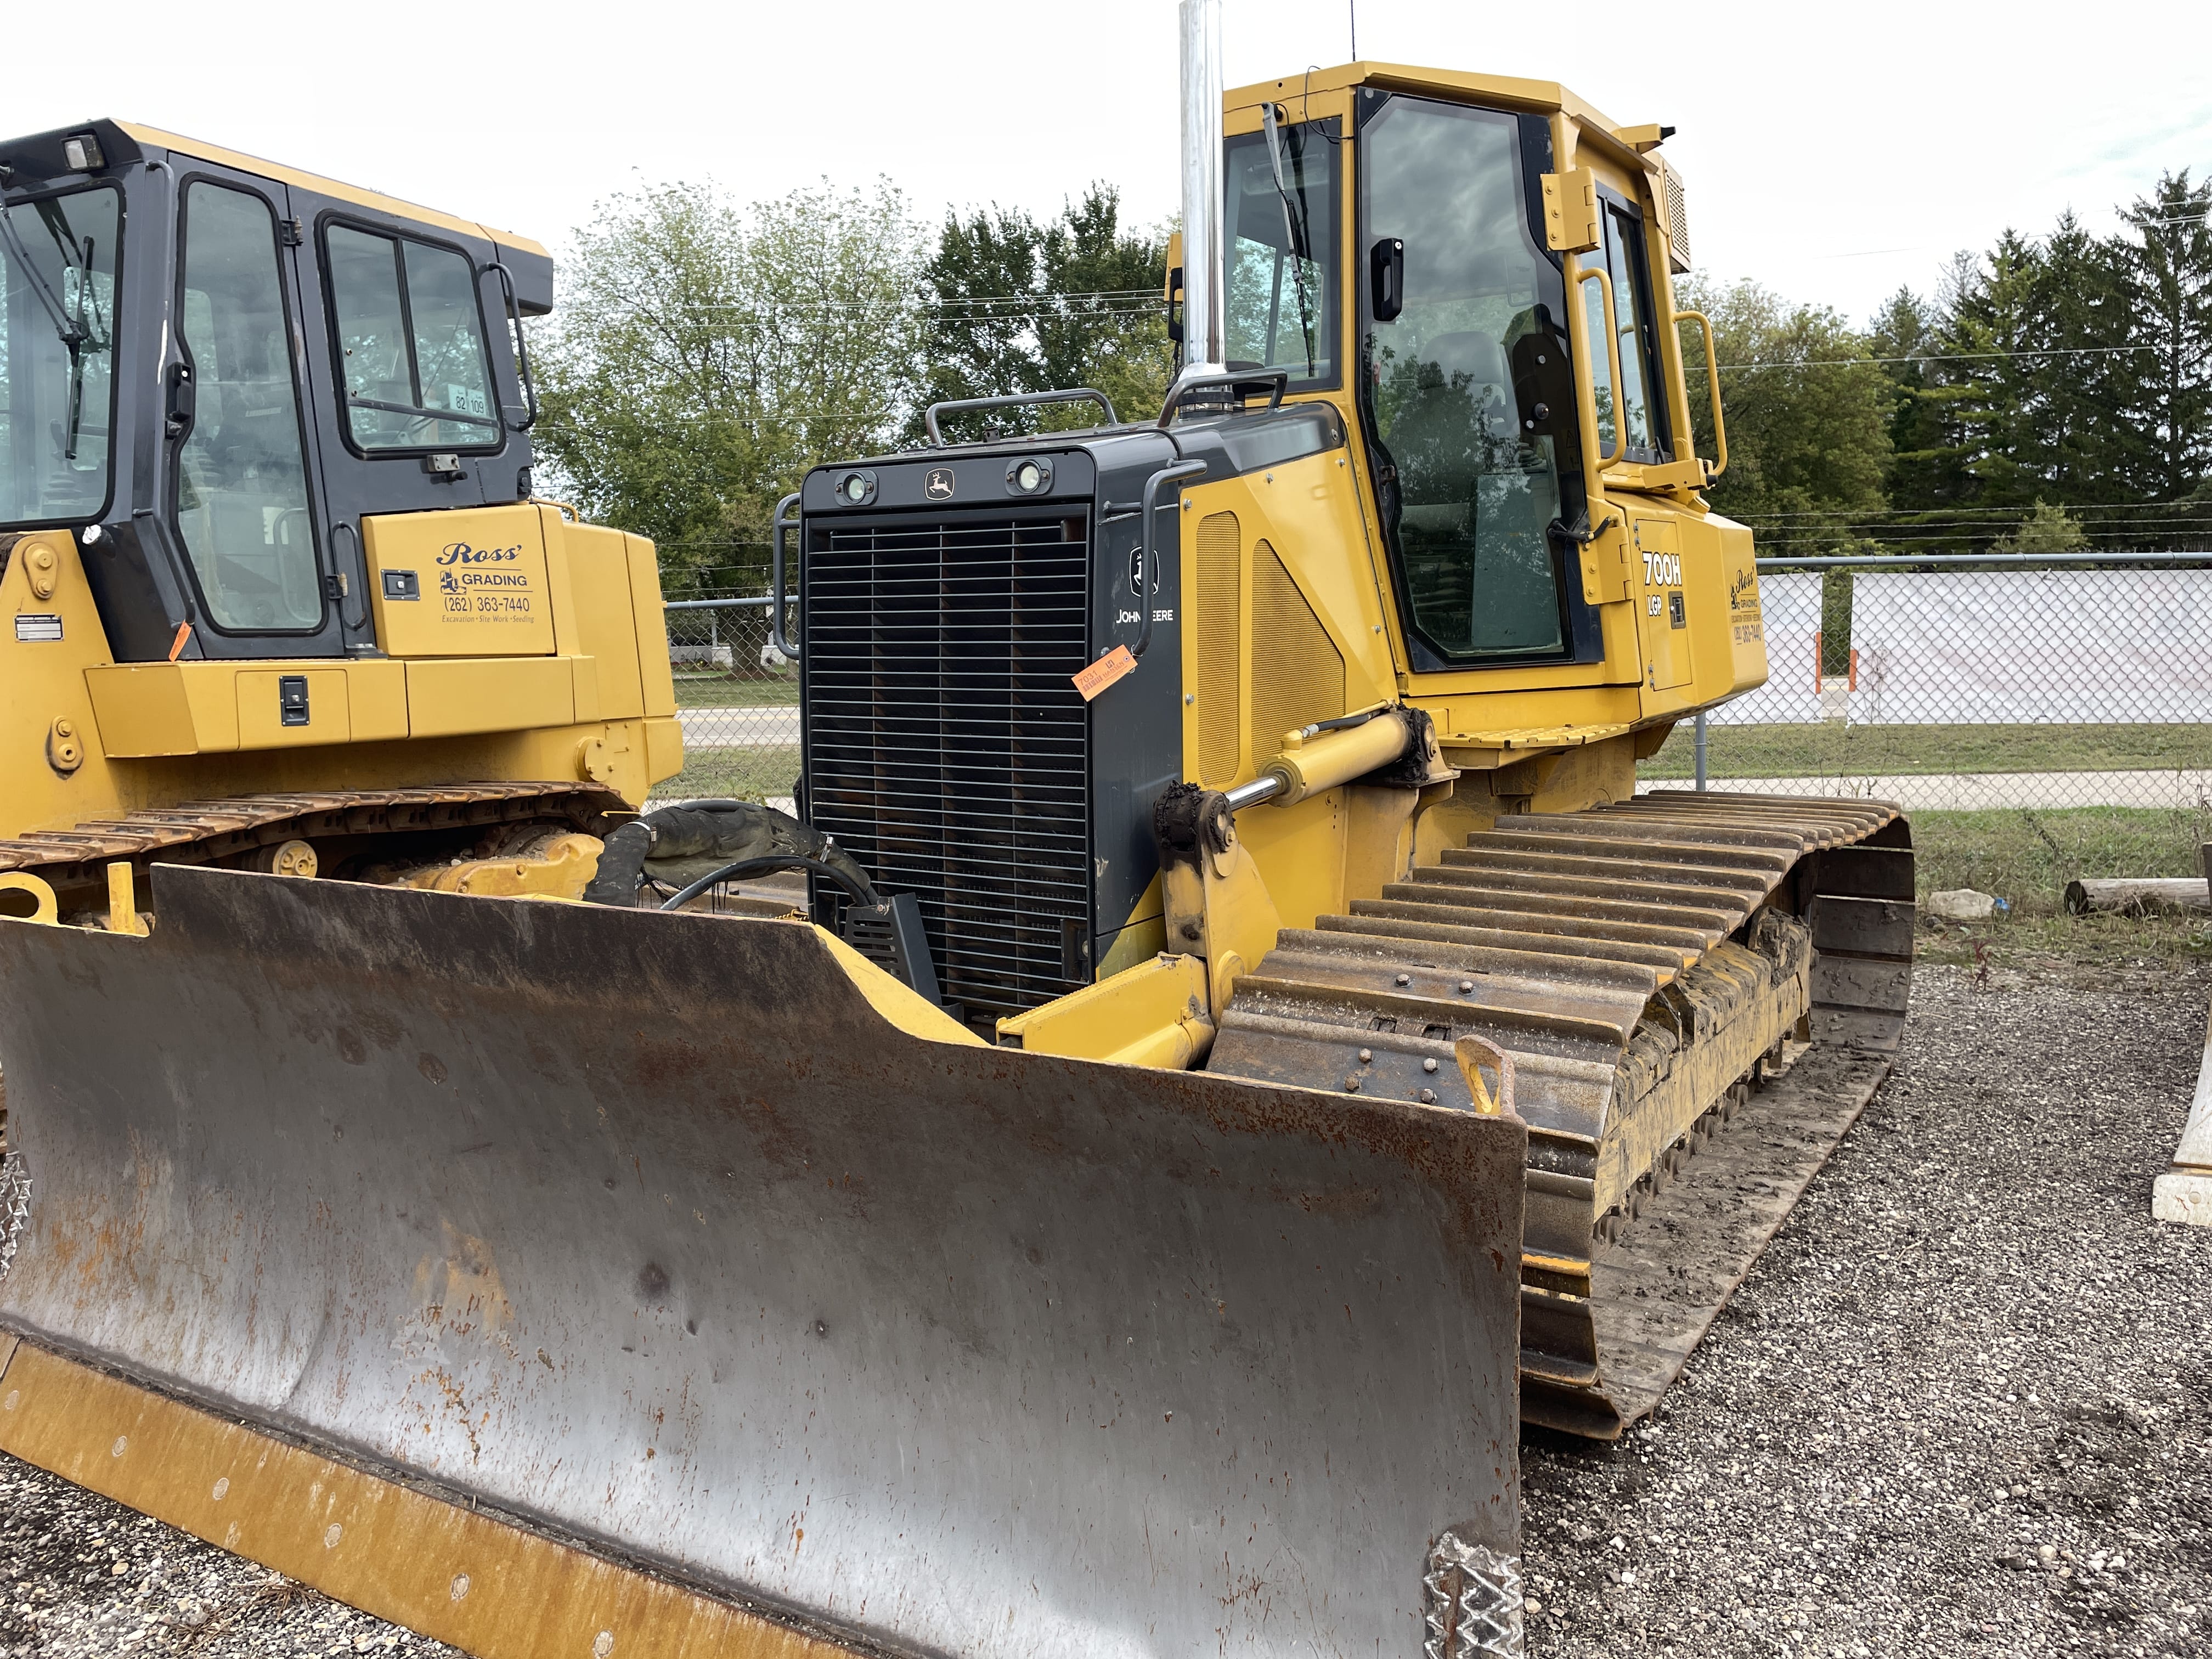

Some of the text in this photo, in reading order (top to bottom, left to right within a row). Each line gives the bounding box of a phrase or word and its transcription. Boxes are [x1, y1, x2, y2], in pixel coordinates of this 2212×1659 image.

[456, 396, 465, 409] 82
[471, 400, 483, 414] 109
[436, 541, 522, 565] Ross'
[1642, 551, 1682, 586] 700H
[462, 574, 527, 586] GRADING
[444, 597, 529, 612] (262) 363-7440
[1647, 595, 1662, 617] LGP
[1740, 599, 1758, 608] GRADING
[513, 615, 534, 624] Seeding
[1116, 609, 1173, 623] JOHN EERE
[1102, 661, 1125, 678] HANSEN
[1079, 670, 1098, 685] 7031
